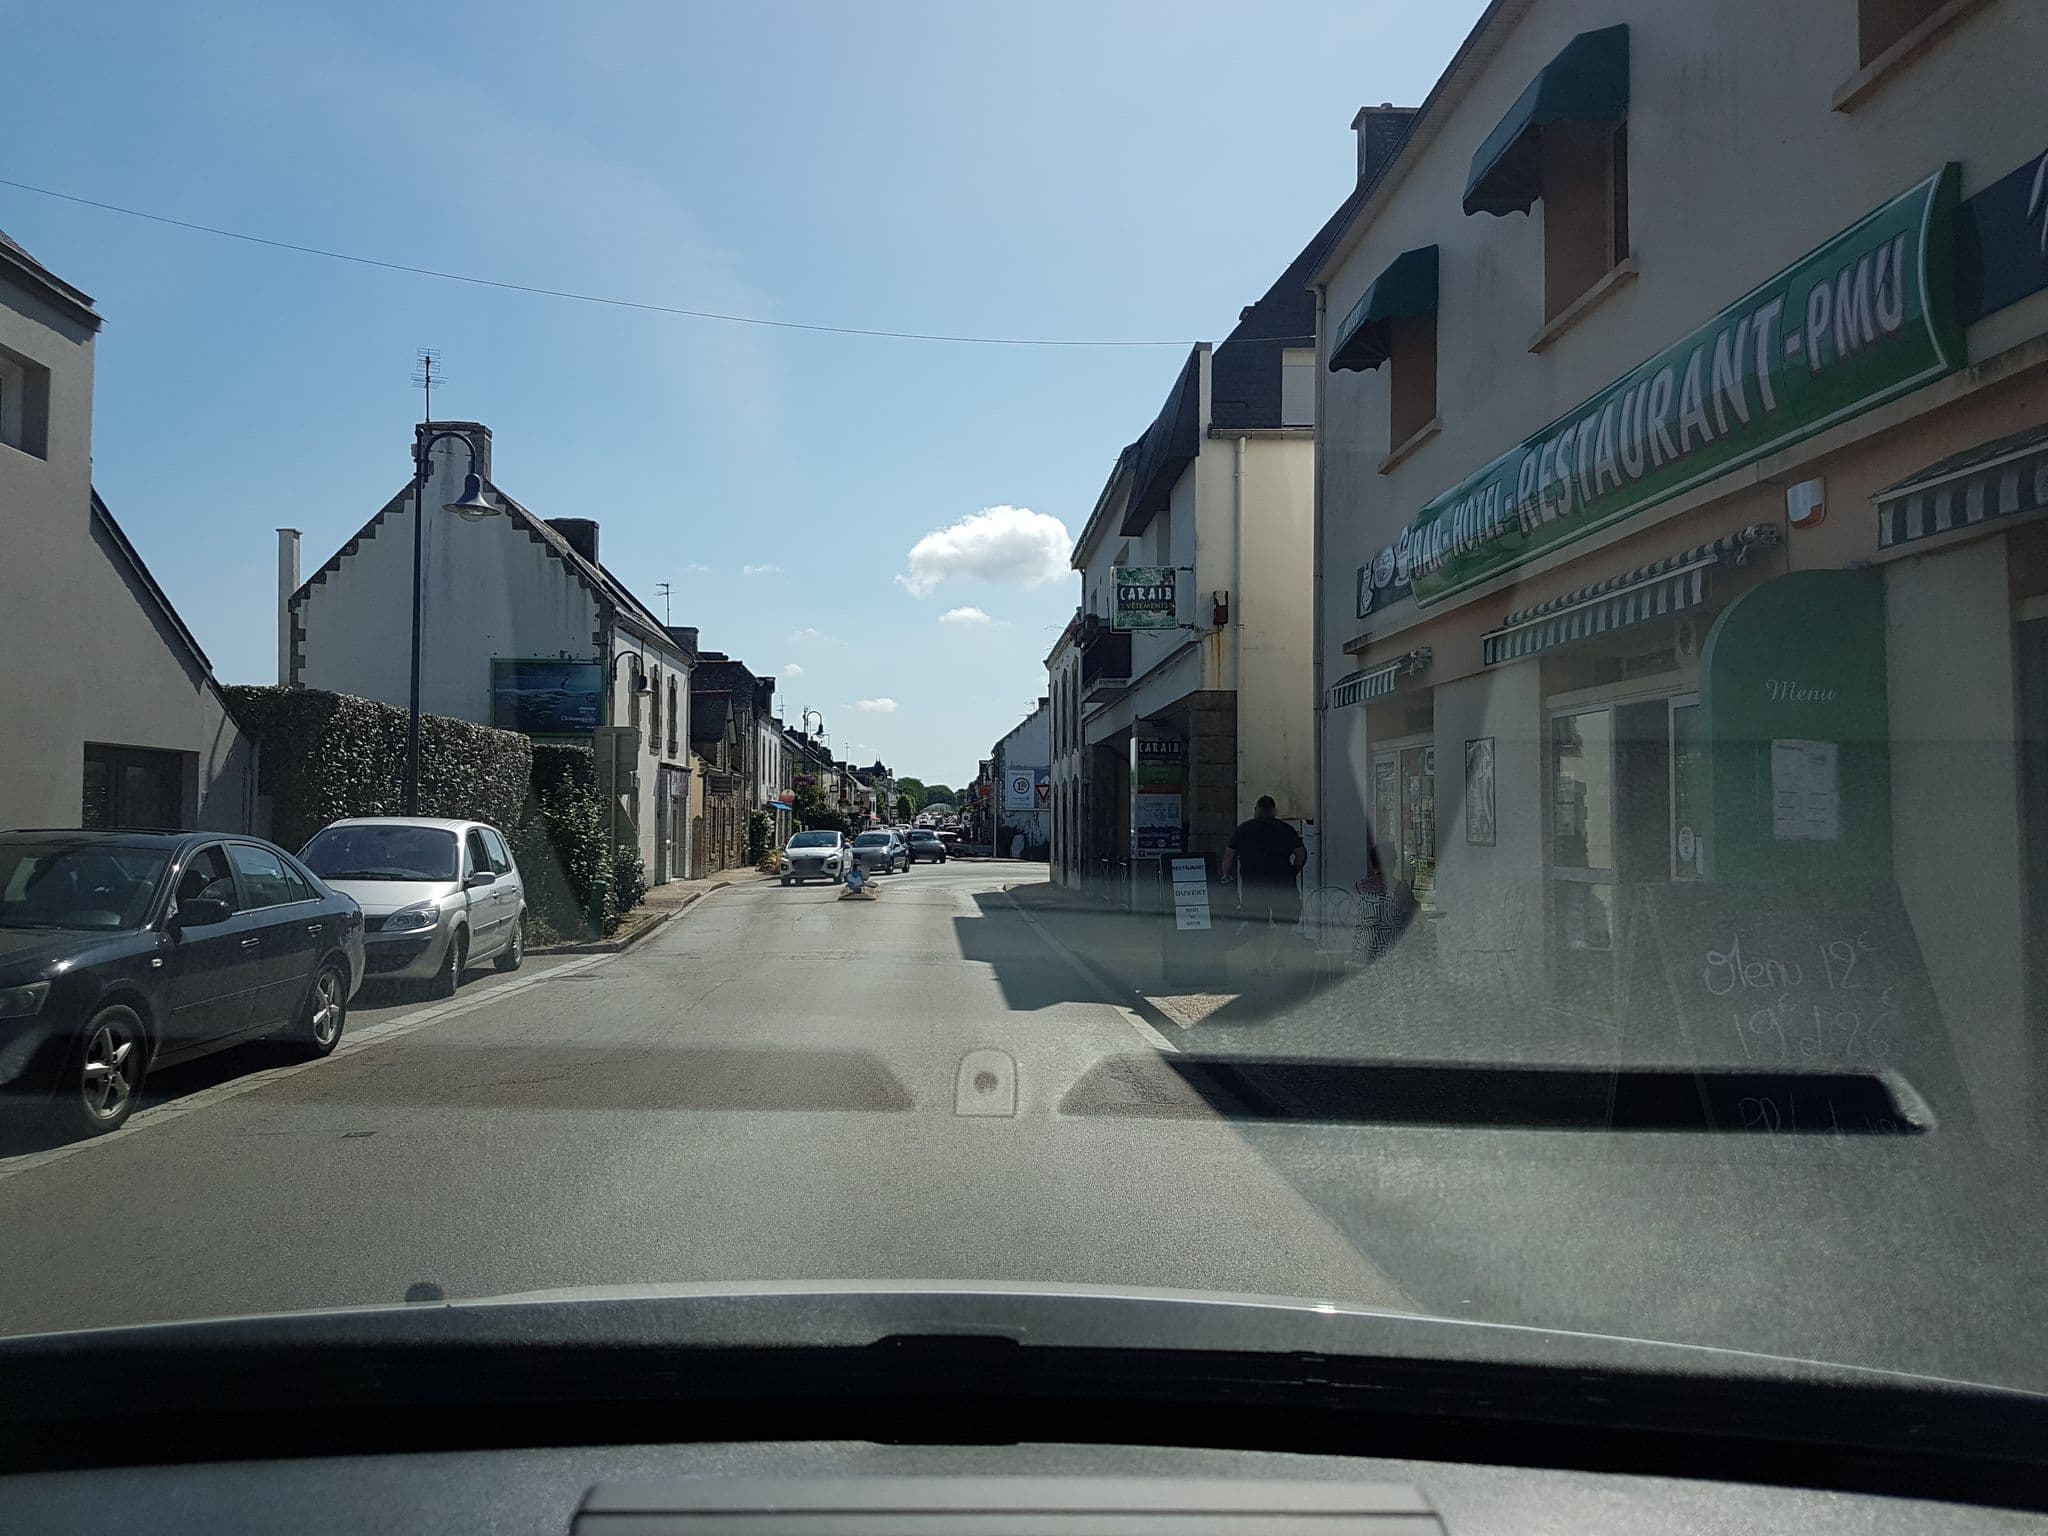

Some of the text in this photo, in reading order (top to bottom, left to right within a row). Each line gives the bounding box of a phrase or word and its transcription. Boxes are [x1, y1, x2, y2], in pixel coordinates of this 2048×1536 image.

[1120, 587, 1172, 600] CARAIB
[1766, 679, 1836, 701] Menu
[1139, 742, 1179, 753] CARAIB
[1175, 889, 1206, 897] OUVERT
